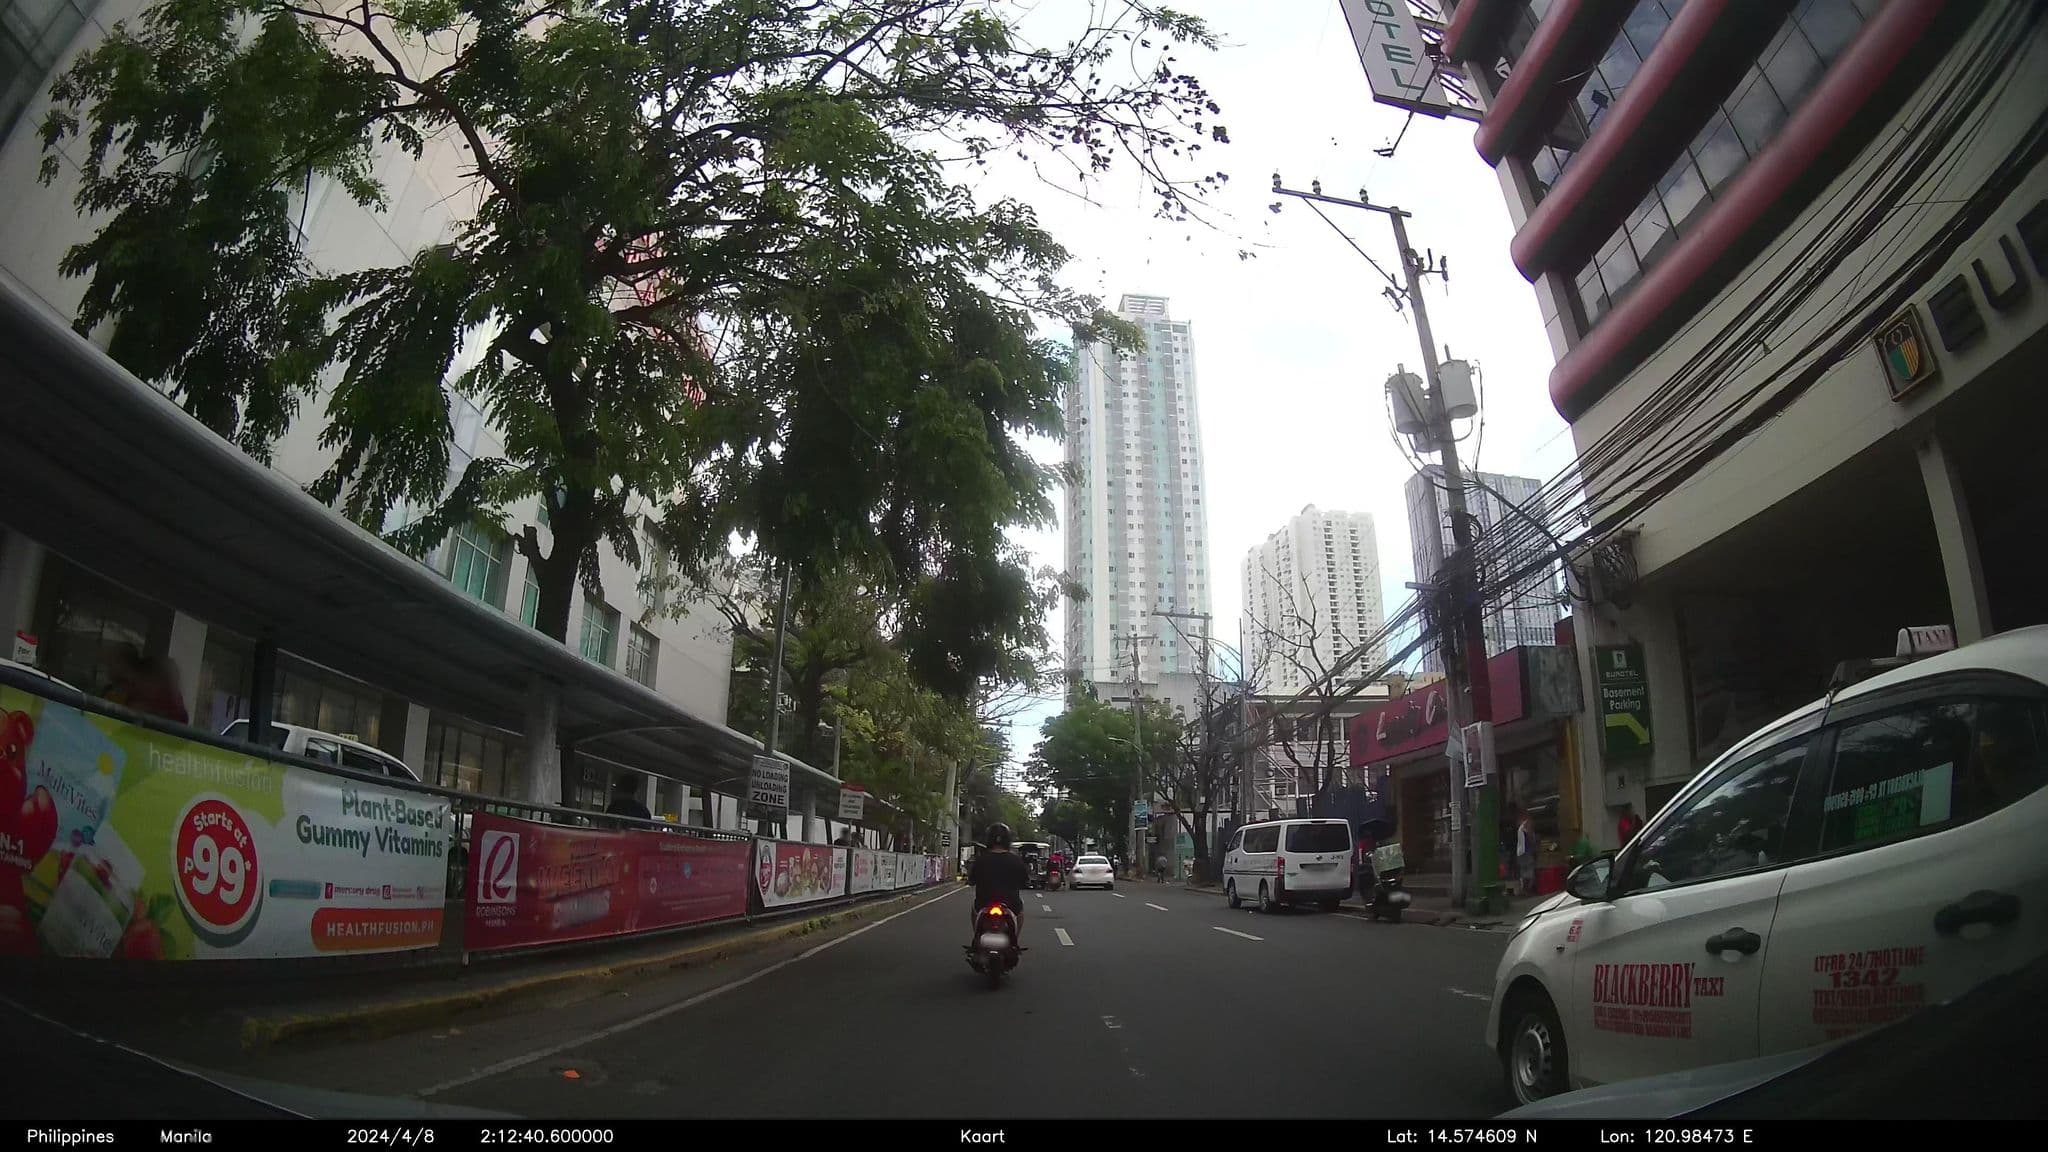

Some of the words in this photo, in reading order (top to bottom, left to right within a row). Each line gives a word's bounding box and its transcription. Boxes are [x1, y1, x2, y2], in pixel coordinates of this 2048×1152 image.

[1603, 685, 1645, 699] Basement
[1609, 699, 1641, 711] Parking
[752, 769, 761, 778] NO
[762, 770, 788, 783] LOADING
[751, 780, 787, 793] UNLOADING
[752, 791, 785, 805] ZONE
[341, 788, 443, 829] Plant-Based
[193, 811, 233, 832] Starts
[233, 827, 248, 849] at
[296, 814, 370, 858] Gummy
[374, 825, 443, 858] Vitamins
[326, 920, 434, 937] HEALTHFUSION.PH
[1594, 962, 1695, 1008] BLACKBERRY
[1694, 977, 1725, 997] TAXI
[1828, 969, 1901, 988] 1342
